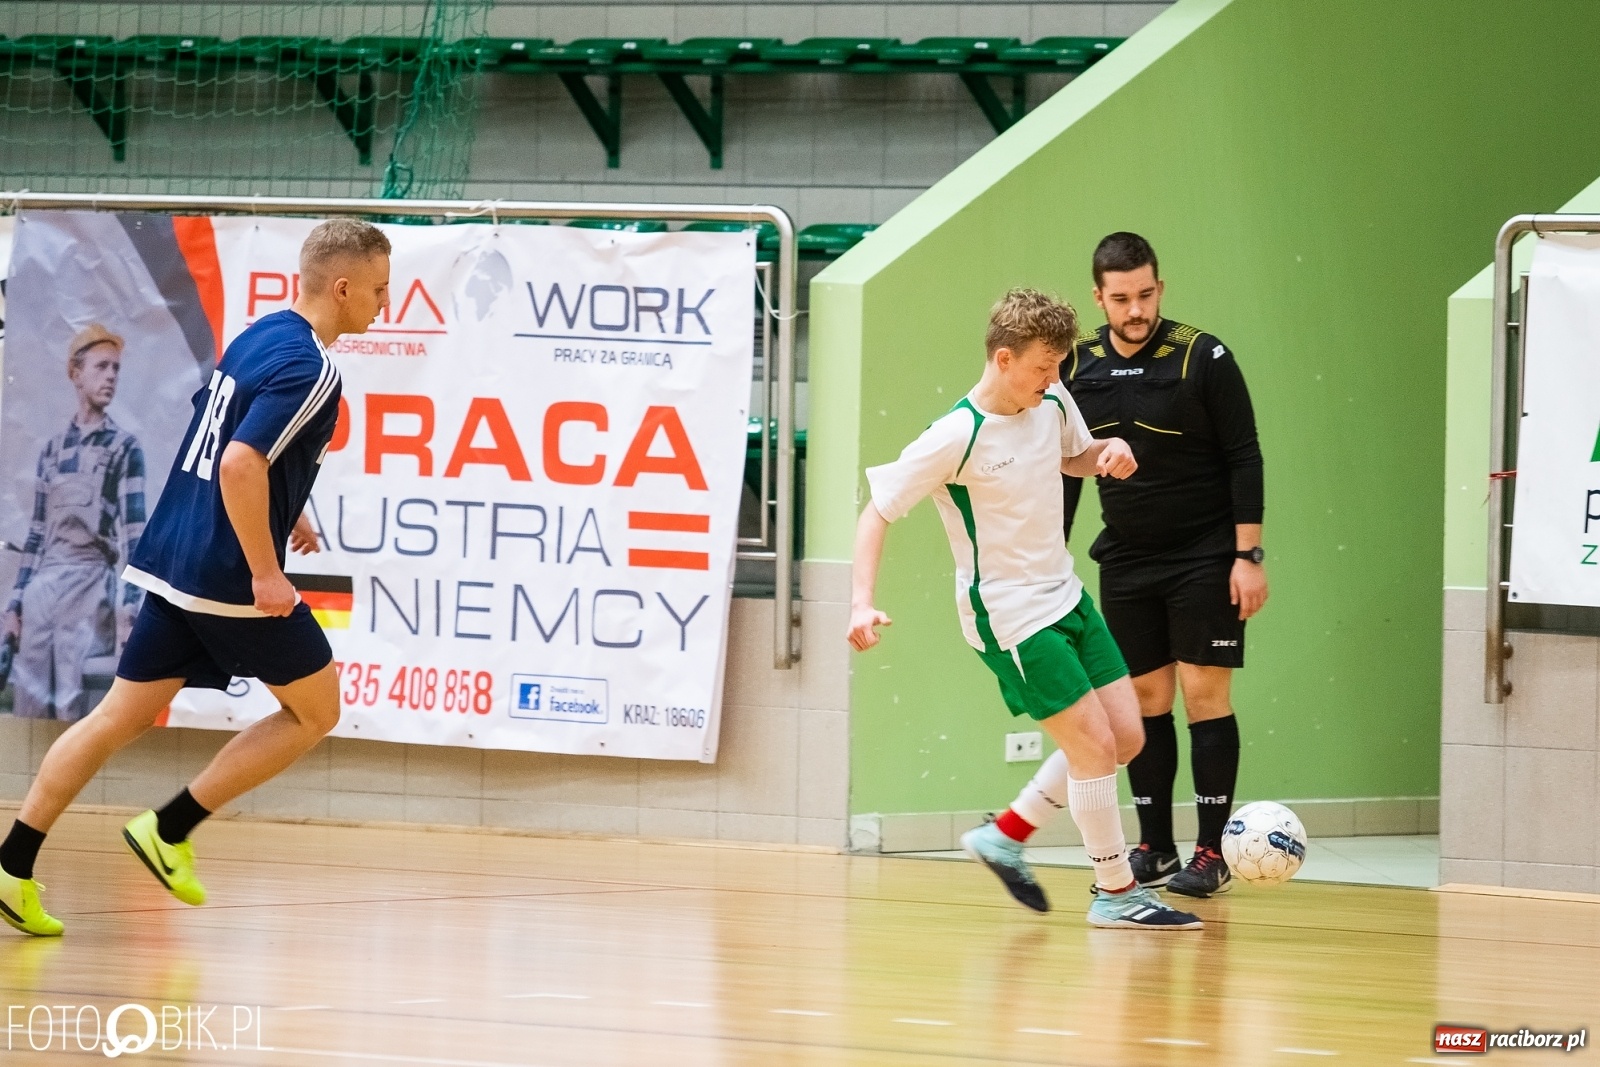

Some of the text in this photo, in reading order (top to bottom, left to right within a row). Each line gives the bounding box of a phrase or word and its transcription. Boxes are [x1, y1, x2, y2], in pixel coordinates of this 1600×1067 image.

[526, 281, 716, 336] WORK
[328, 335, 428, 356] OŚREDNICTWA
[554, 348, 597, 363] PRACY
[600, 350, 618, 364] ZA
[181, 369, 236, 481] 18
[369, 575, 711, 652] NIEMCY
[388, 665, 438, 711] 408
[443, 669, 493, 715] 858
[665, 707, 706, 729] 18606
